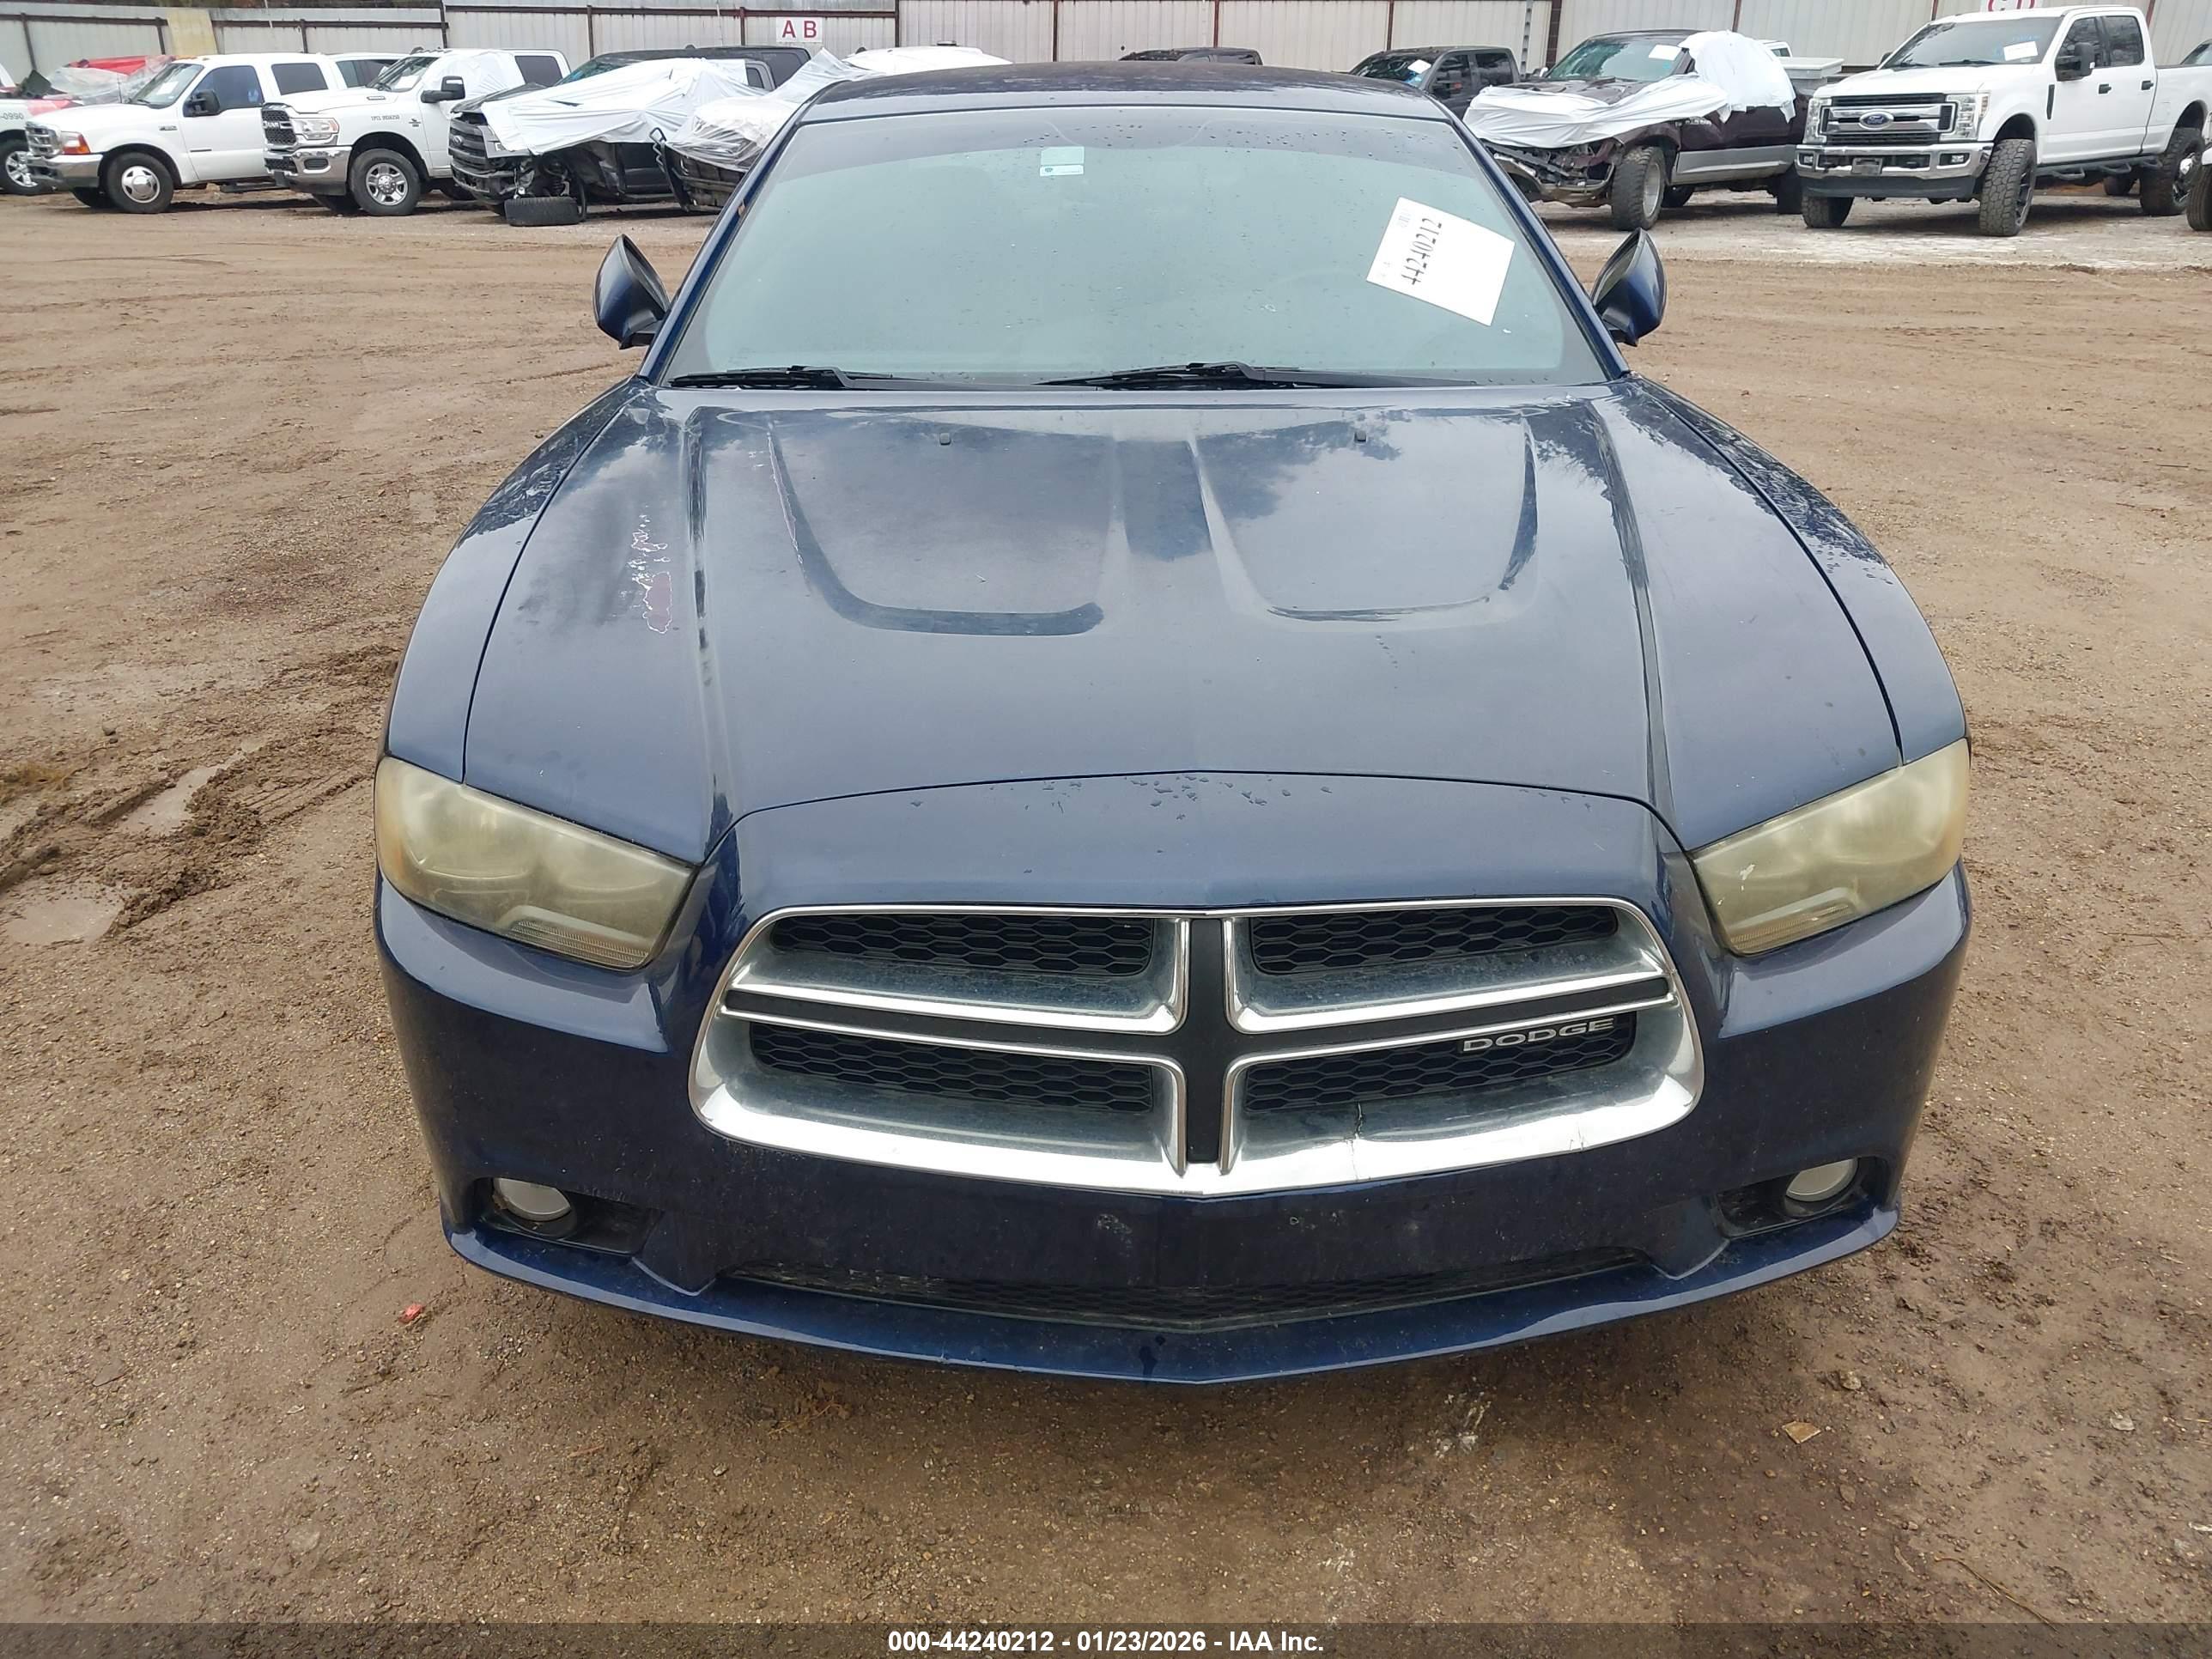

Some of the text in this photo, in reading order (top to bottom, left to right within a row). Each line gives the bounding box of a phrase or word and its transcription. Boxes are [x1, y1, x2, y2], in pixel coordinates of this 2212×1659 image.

[782, 20, 817, 38] A B
[1401, 218, 1442, 285] 44240212
[1463, 1018, 1614, 1051] DODGE
